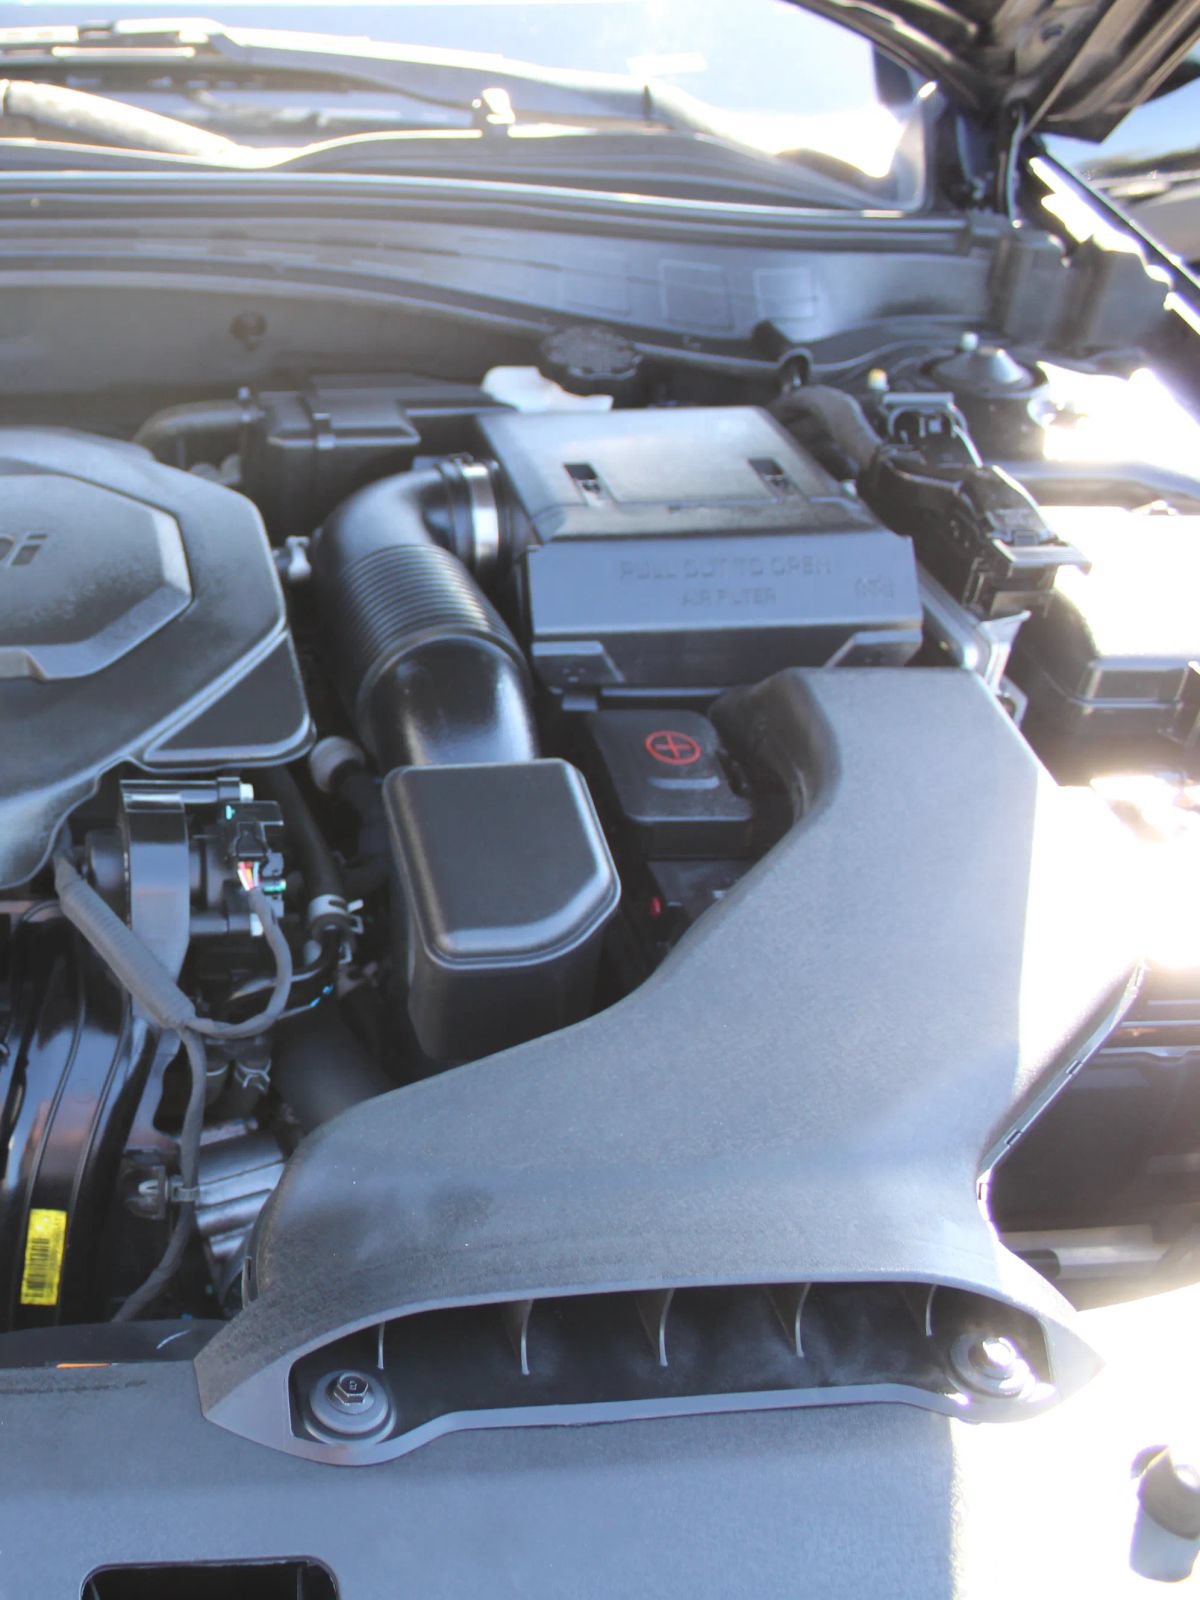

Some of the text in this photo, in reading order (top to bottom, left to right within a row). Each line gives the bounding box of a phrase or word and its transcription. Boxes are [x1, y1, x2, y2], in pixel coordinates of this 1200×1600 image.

[620, 554, 831, 579] PULL OUT TO OPEN
